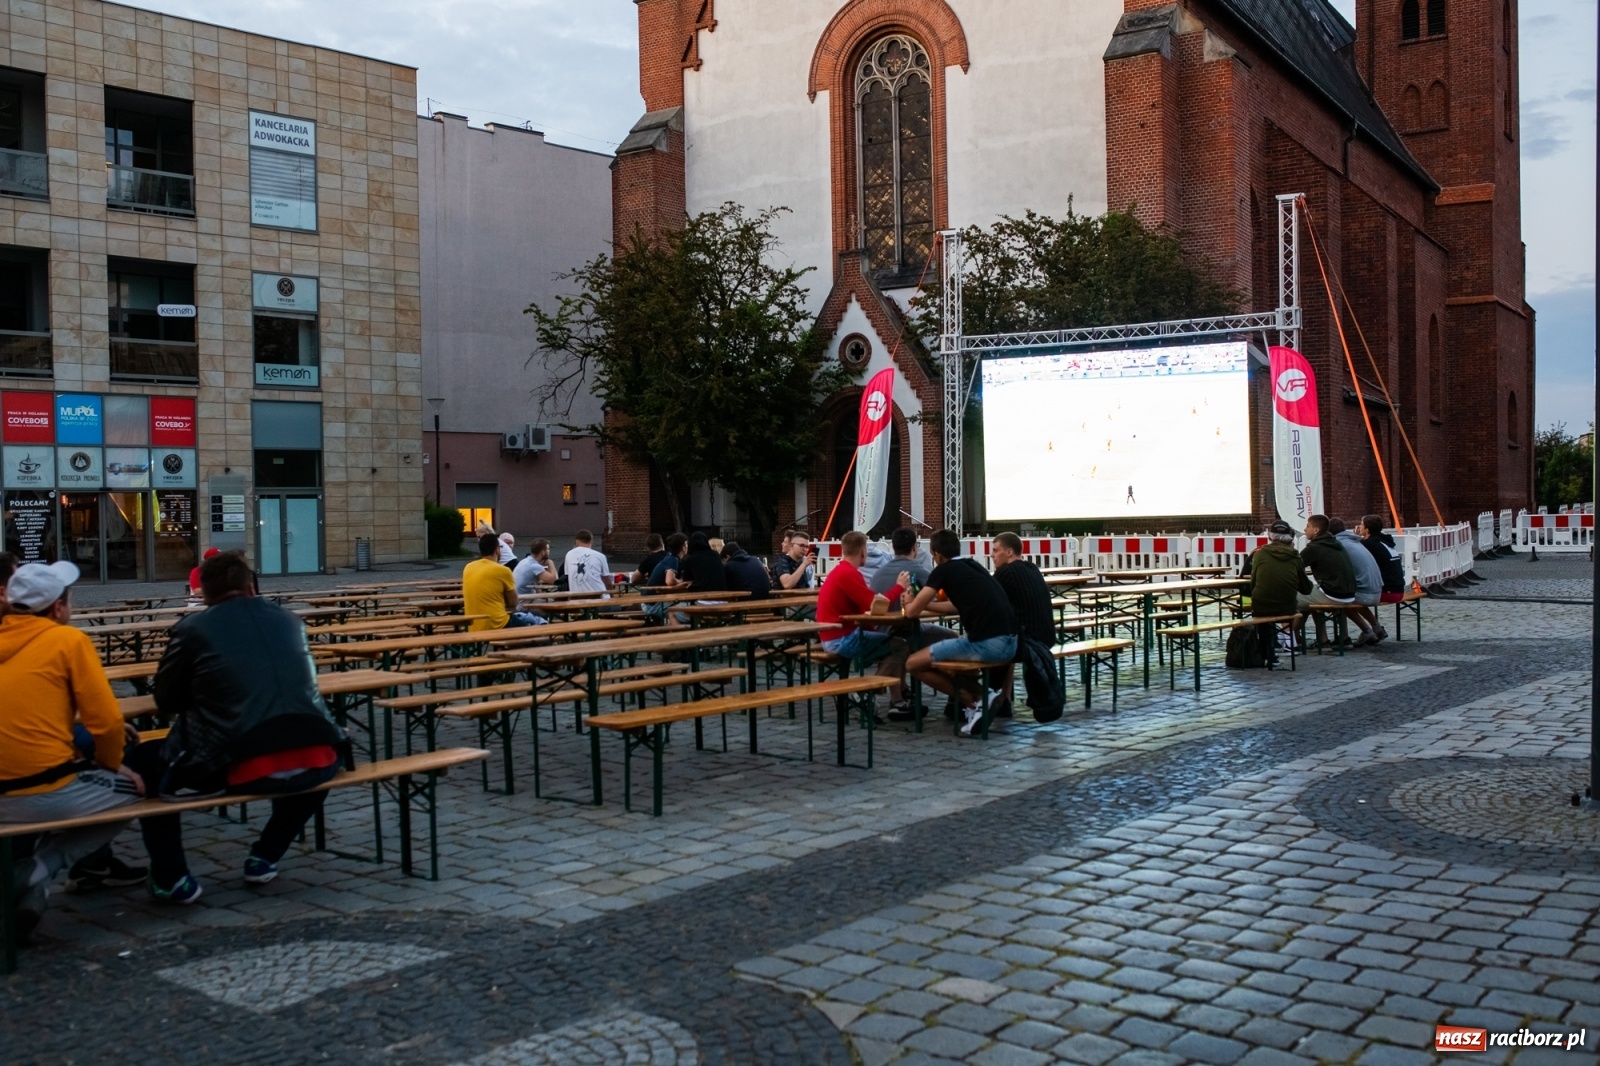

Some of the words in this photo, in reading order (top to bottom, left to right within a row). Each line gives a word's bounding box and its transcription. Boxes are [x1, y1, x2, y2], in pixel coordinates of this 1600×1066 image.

[255, 118, 309, 135] KANCELARIA
[254, 131, 310, 147] ADWOKACKA
[263, 366, 311, 379] kemøn
[61, 406, 98, 416] MUPOL
